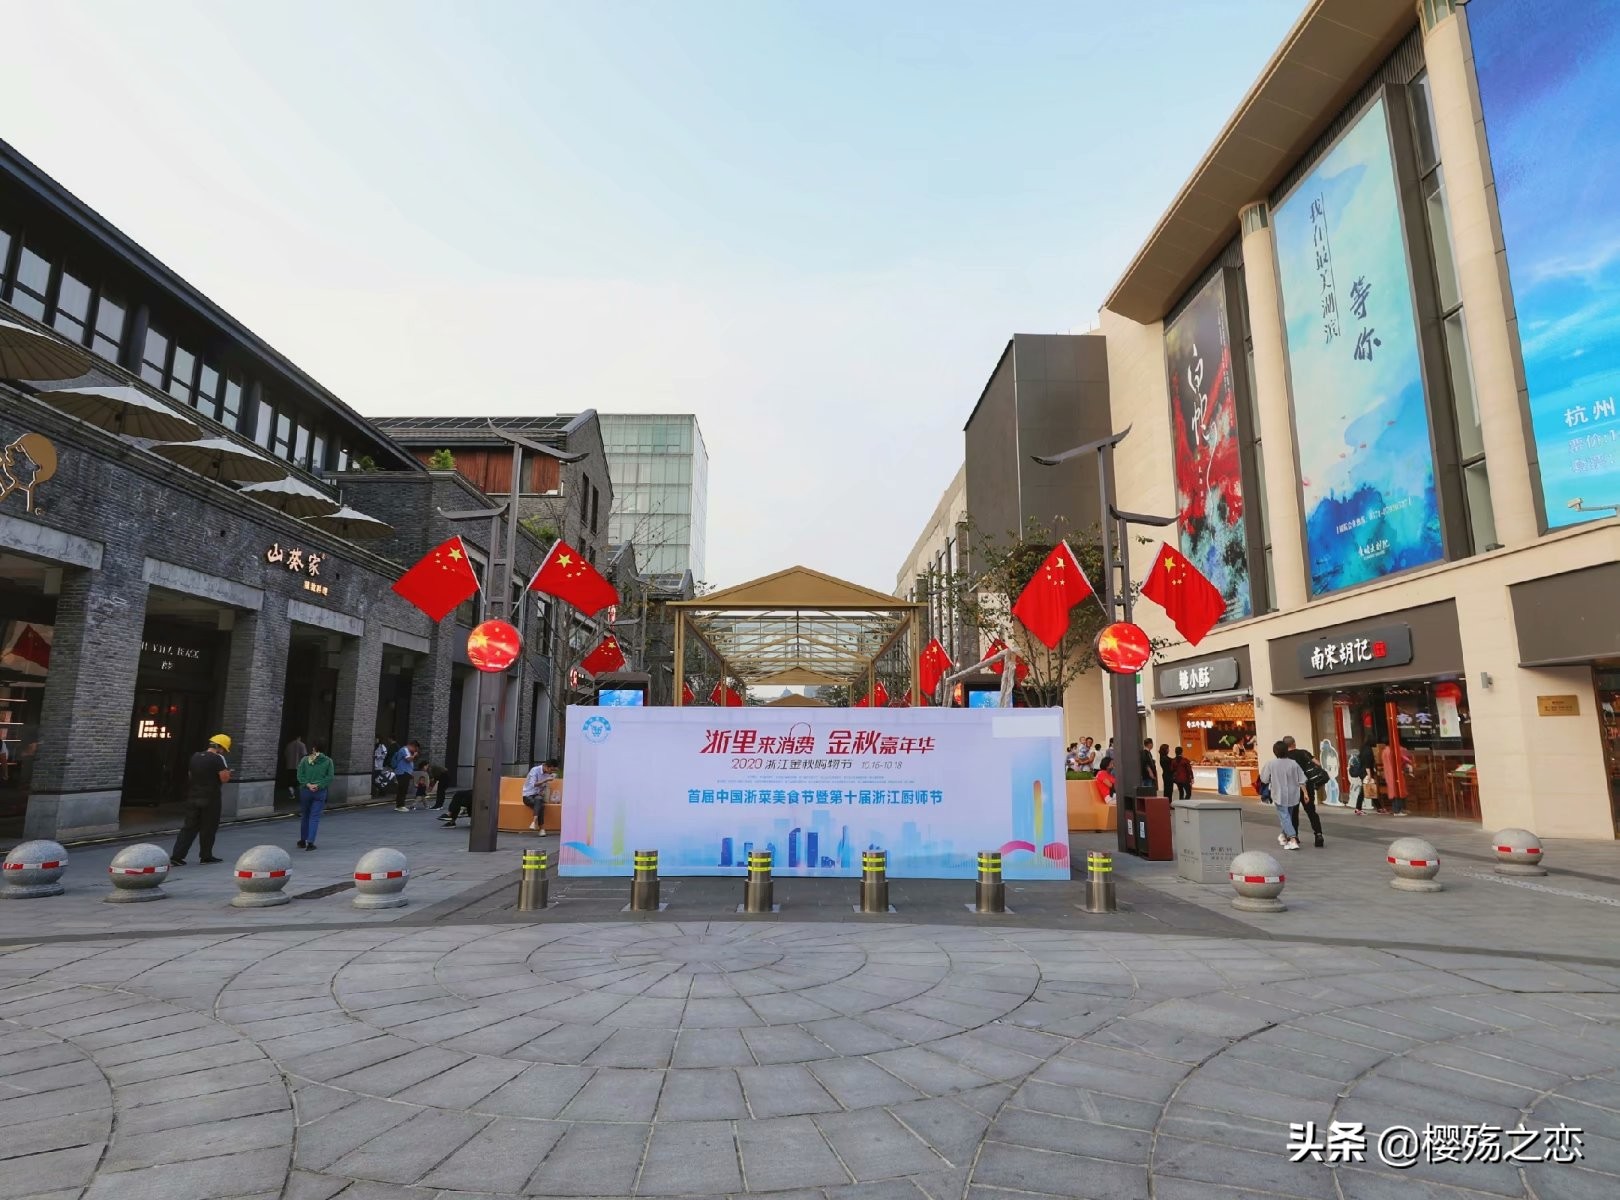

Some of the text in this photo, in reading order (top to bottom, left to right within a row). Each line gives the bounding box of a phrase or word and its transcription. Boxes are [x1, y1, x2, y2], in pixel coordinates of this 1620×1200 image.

[1309, 198, 1338, 344] 我在最美湖滨
[1350, 275, 1382, 362] 等你
[1564, 396, 1615, 428] 杭州
[267, 543, 321, 577] 山葵家
[1311, 638, 1372, 671] 南宋胡记
[699, 730, 936, 756] 浙里来消费 金秋嘉年华
[731, 758, 763, 770] 2020
[764, 758, 853, 770] 浙江金秋购物节
[687, 789, 943, 805] 首届中国浙菜美食节暨第十届浙江厨师节
